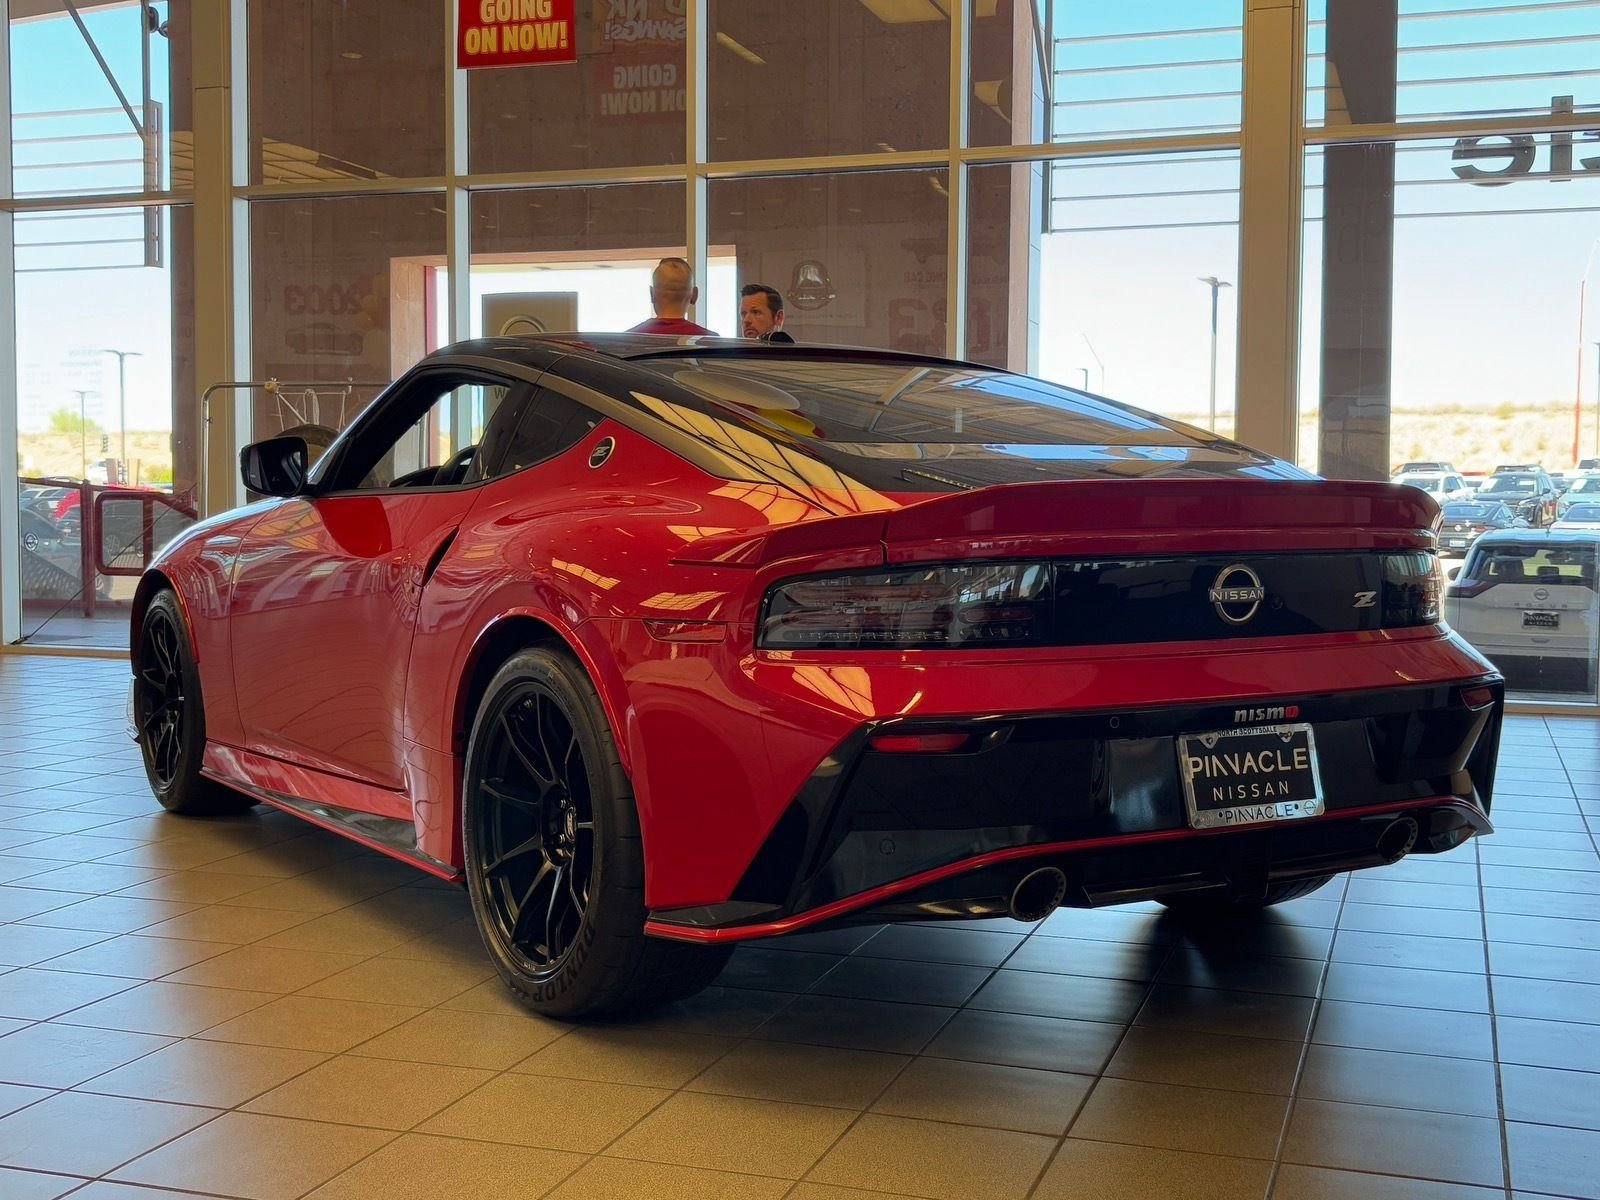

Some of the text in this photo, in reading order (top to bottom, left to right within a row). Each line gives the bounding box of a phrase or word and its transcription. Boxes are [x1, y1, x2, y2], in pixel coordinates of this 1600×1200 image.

[480, 0, 552, 23] GOING
[465, 21, 568, 54] ON NOW!
[1212, 588, 1264, 600] NISSAN
[1352, 591, 1377, 608] Z
[1217, 726, 1277, 738] NORTH SCOTTSDALE
[1189, 747, 1309, 779] PINNACLE
[1213, 780, 1289, 801] NISSAN
[533, 923, 596, 1002] DUNLOP
